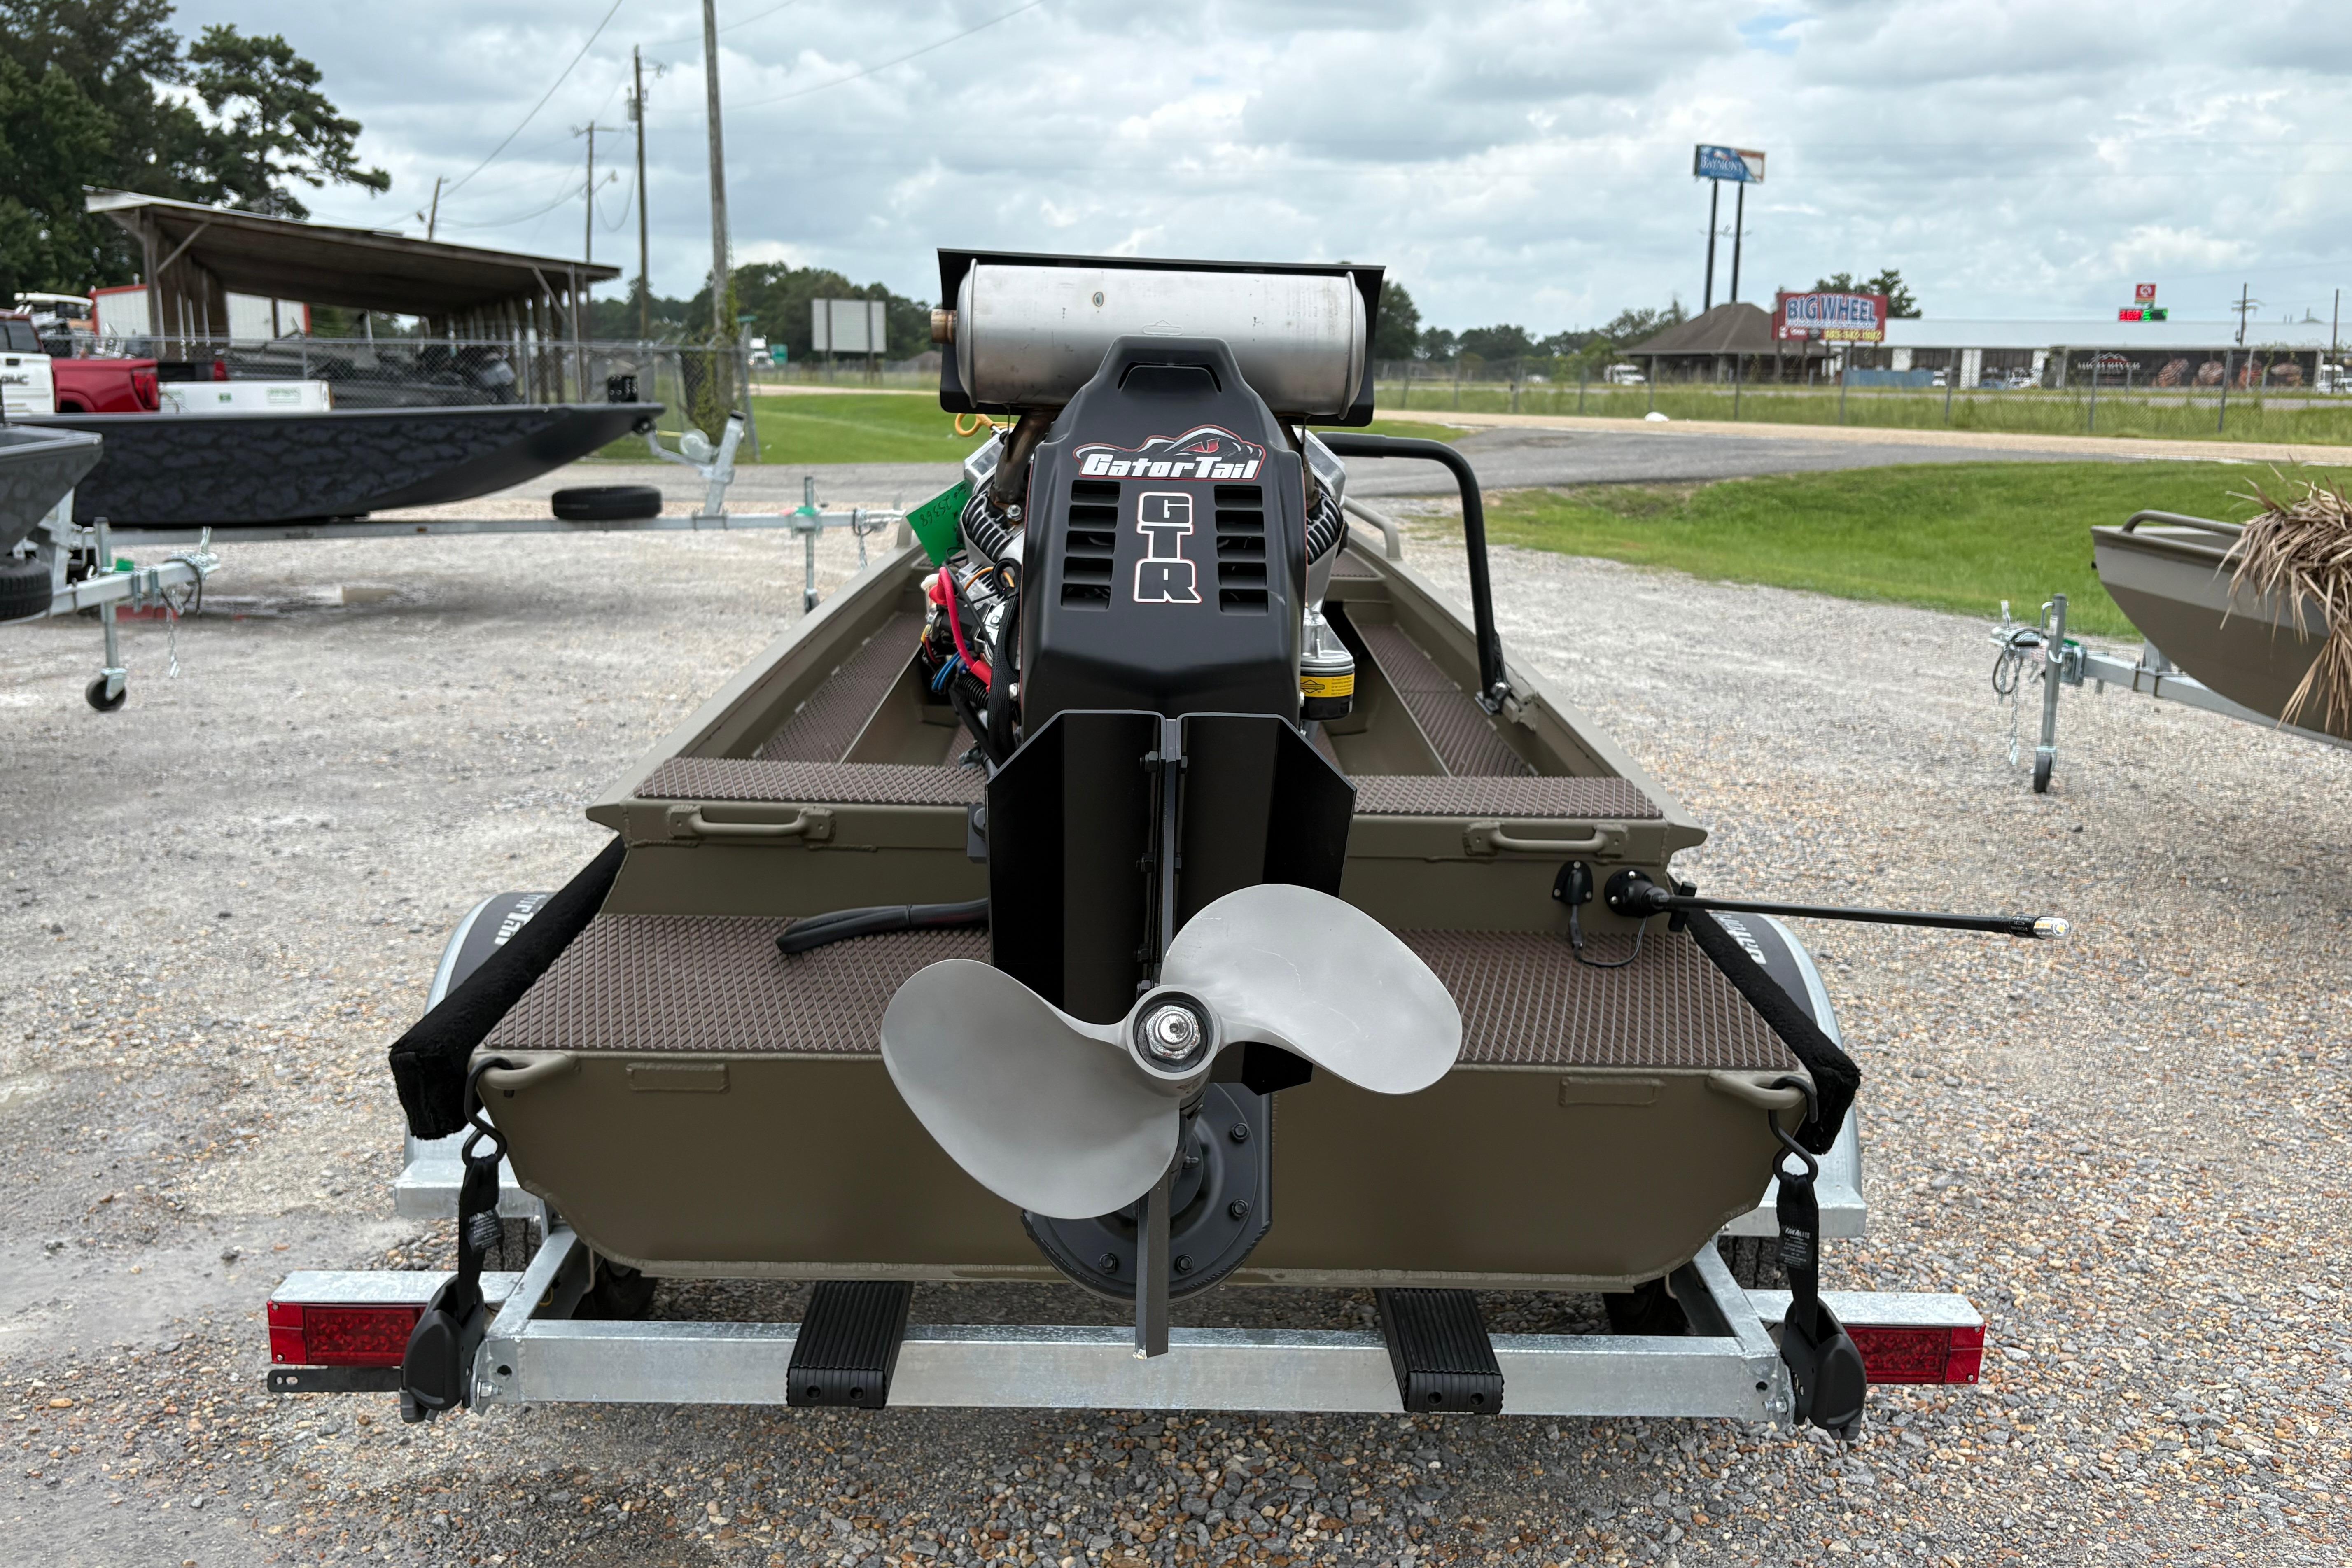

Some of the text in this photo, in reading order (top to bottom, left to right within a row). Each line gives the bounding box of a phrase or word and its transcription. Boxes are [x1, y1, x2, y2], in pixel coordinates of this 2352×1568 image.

[1786, 294, 1878, 322] BIG WHEEL
[1081, 453, 1260, 479] GatorTail
